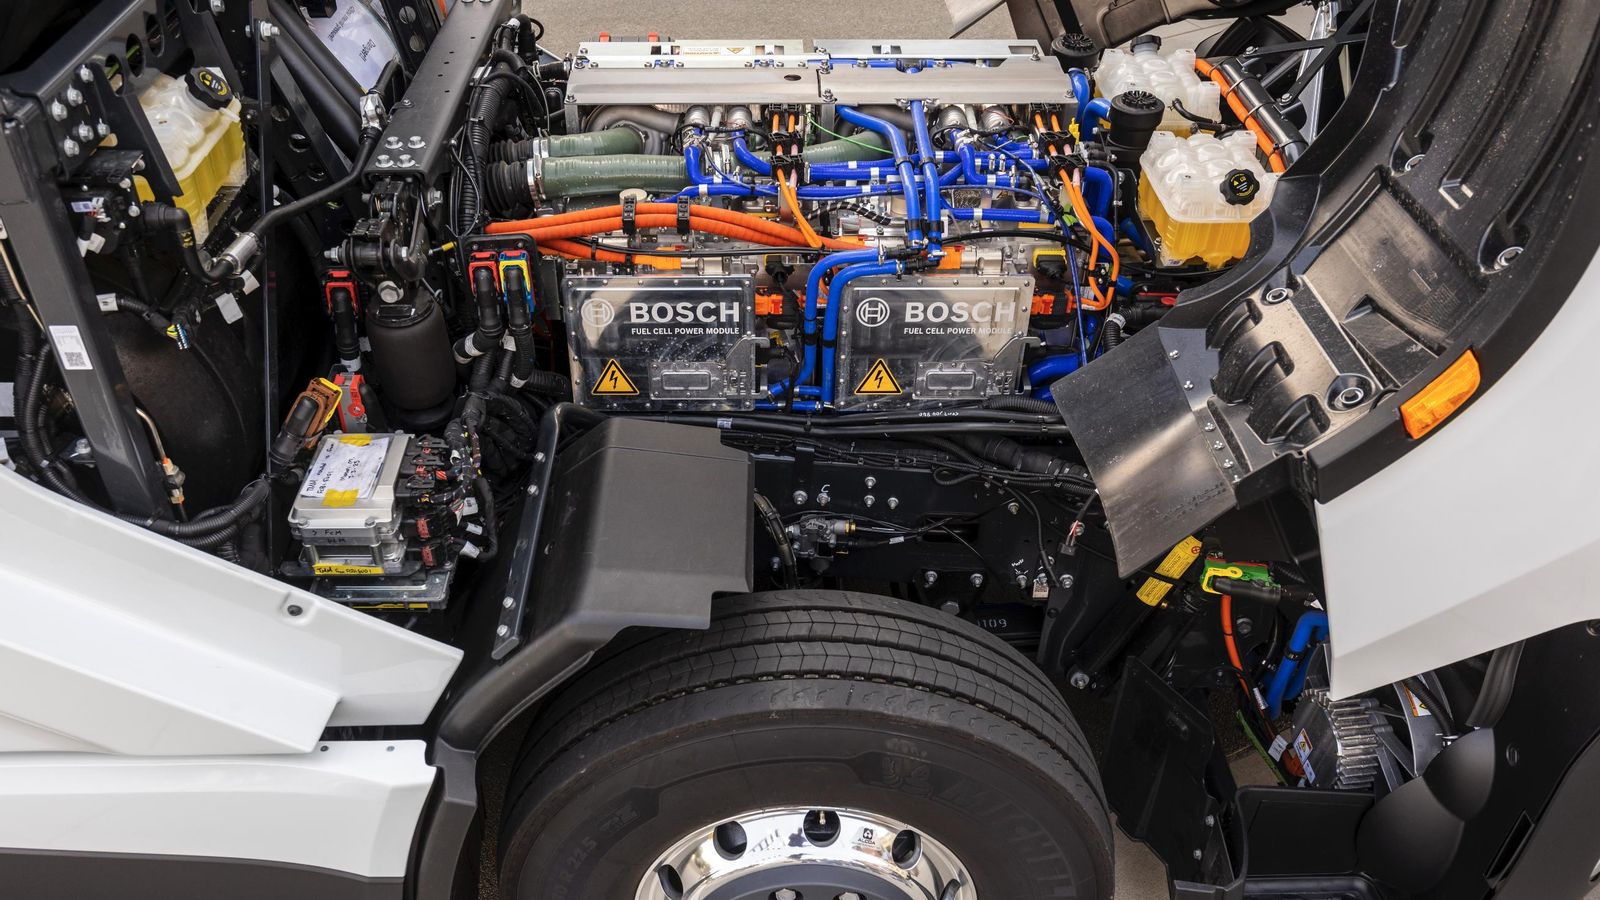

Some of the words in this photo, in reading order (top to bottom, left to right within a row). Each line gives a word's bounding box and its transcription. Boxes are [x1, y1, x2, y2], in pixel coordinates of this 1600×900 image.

[630, 302, 740, 323] BOSCH
[904, 301, 1016, 323] BOSCH
[631, 327, 651, 336] FUEL
[653, 327, 673, 336] CELL
[675, 327, 704, 336] POWER
[706, 327, 740, 336] MODULE
[904, 327, 924, 335] FUEL
[926, 327, 945, 335] CELL
[947, 327, 977, 335] POWER
[978, 327, 1013, 335] MODULE
